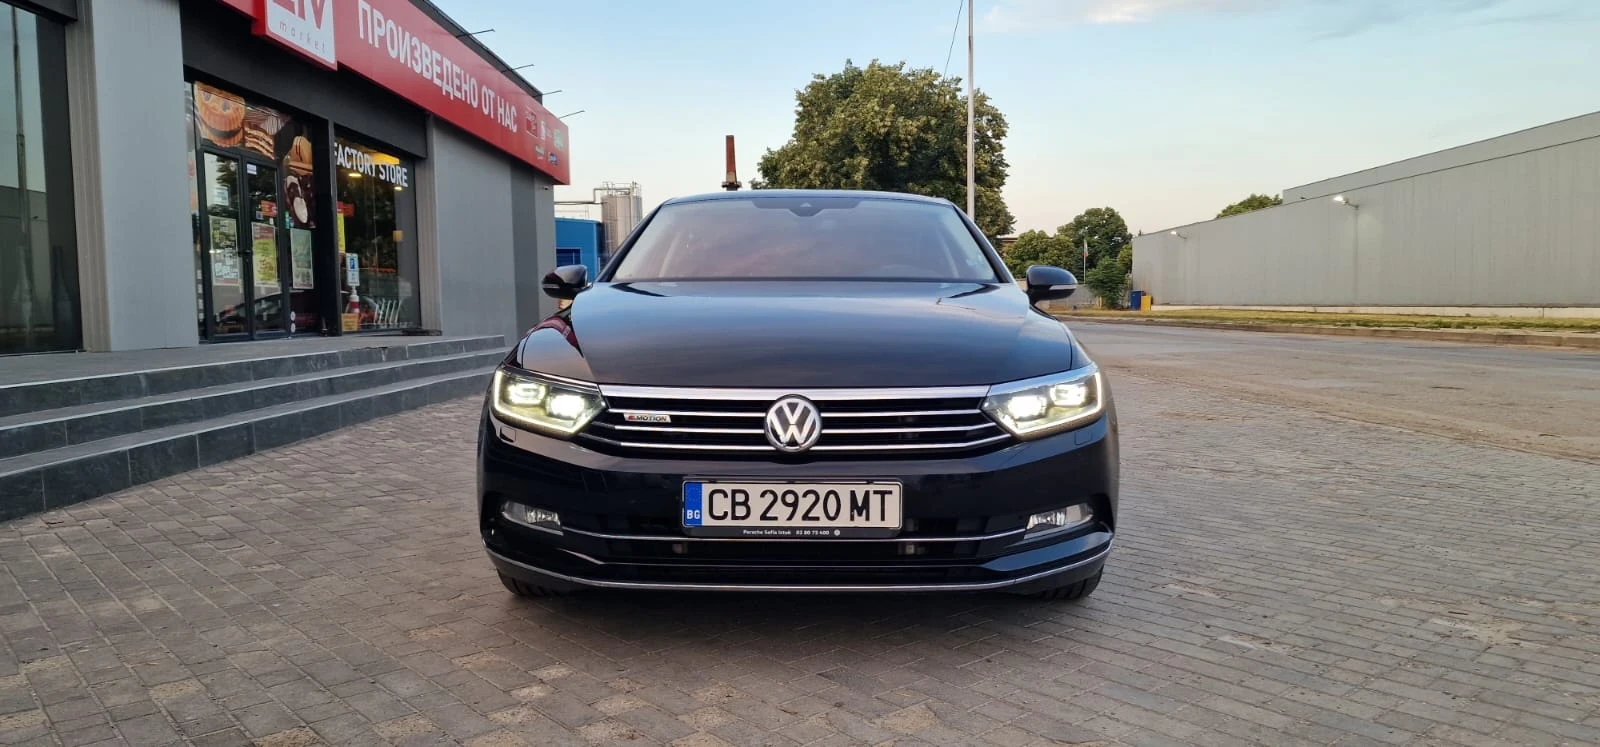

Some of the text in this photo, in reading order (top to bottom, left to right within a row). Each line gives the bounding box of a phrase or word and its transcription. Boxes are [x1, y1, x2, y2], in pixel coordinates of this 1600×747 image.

[280, 21, 326, 53] market
[358, 1, 479, 108] ПРОИЗВЕДЕНО
[481, 85, 495, 119] ОТ
[497, 96, 517, 133] НАС
[379, 163, 408, 187] STORE
[686, 509, 701, 520] BG
[708, 488, 893, 522] CB 2920 MT
